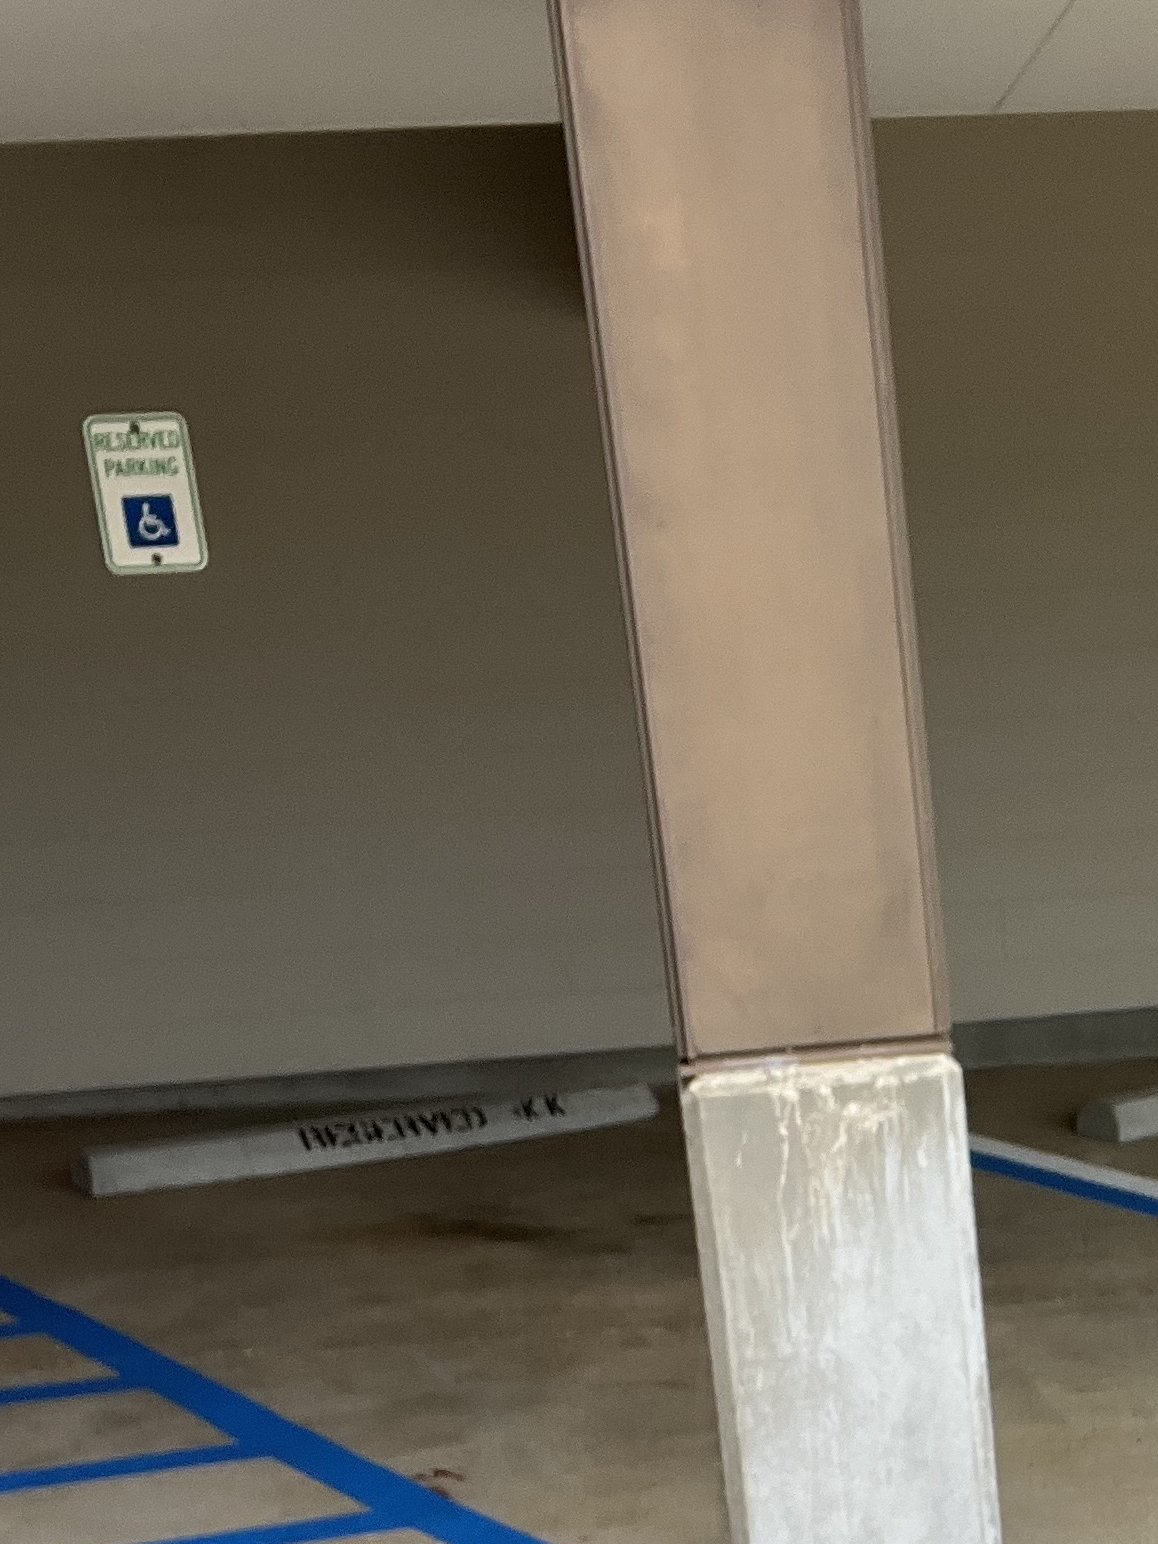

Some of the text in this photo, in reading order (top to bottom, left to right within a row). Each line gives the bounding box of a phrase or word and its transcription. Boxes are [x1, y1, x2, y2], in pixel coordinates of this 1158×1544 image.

[94, 431, 181, 451] RESERVED
[104, 455, 179, 477] PARKING
[297, 1105, 487, 1151] RESERVED
